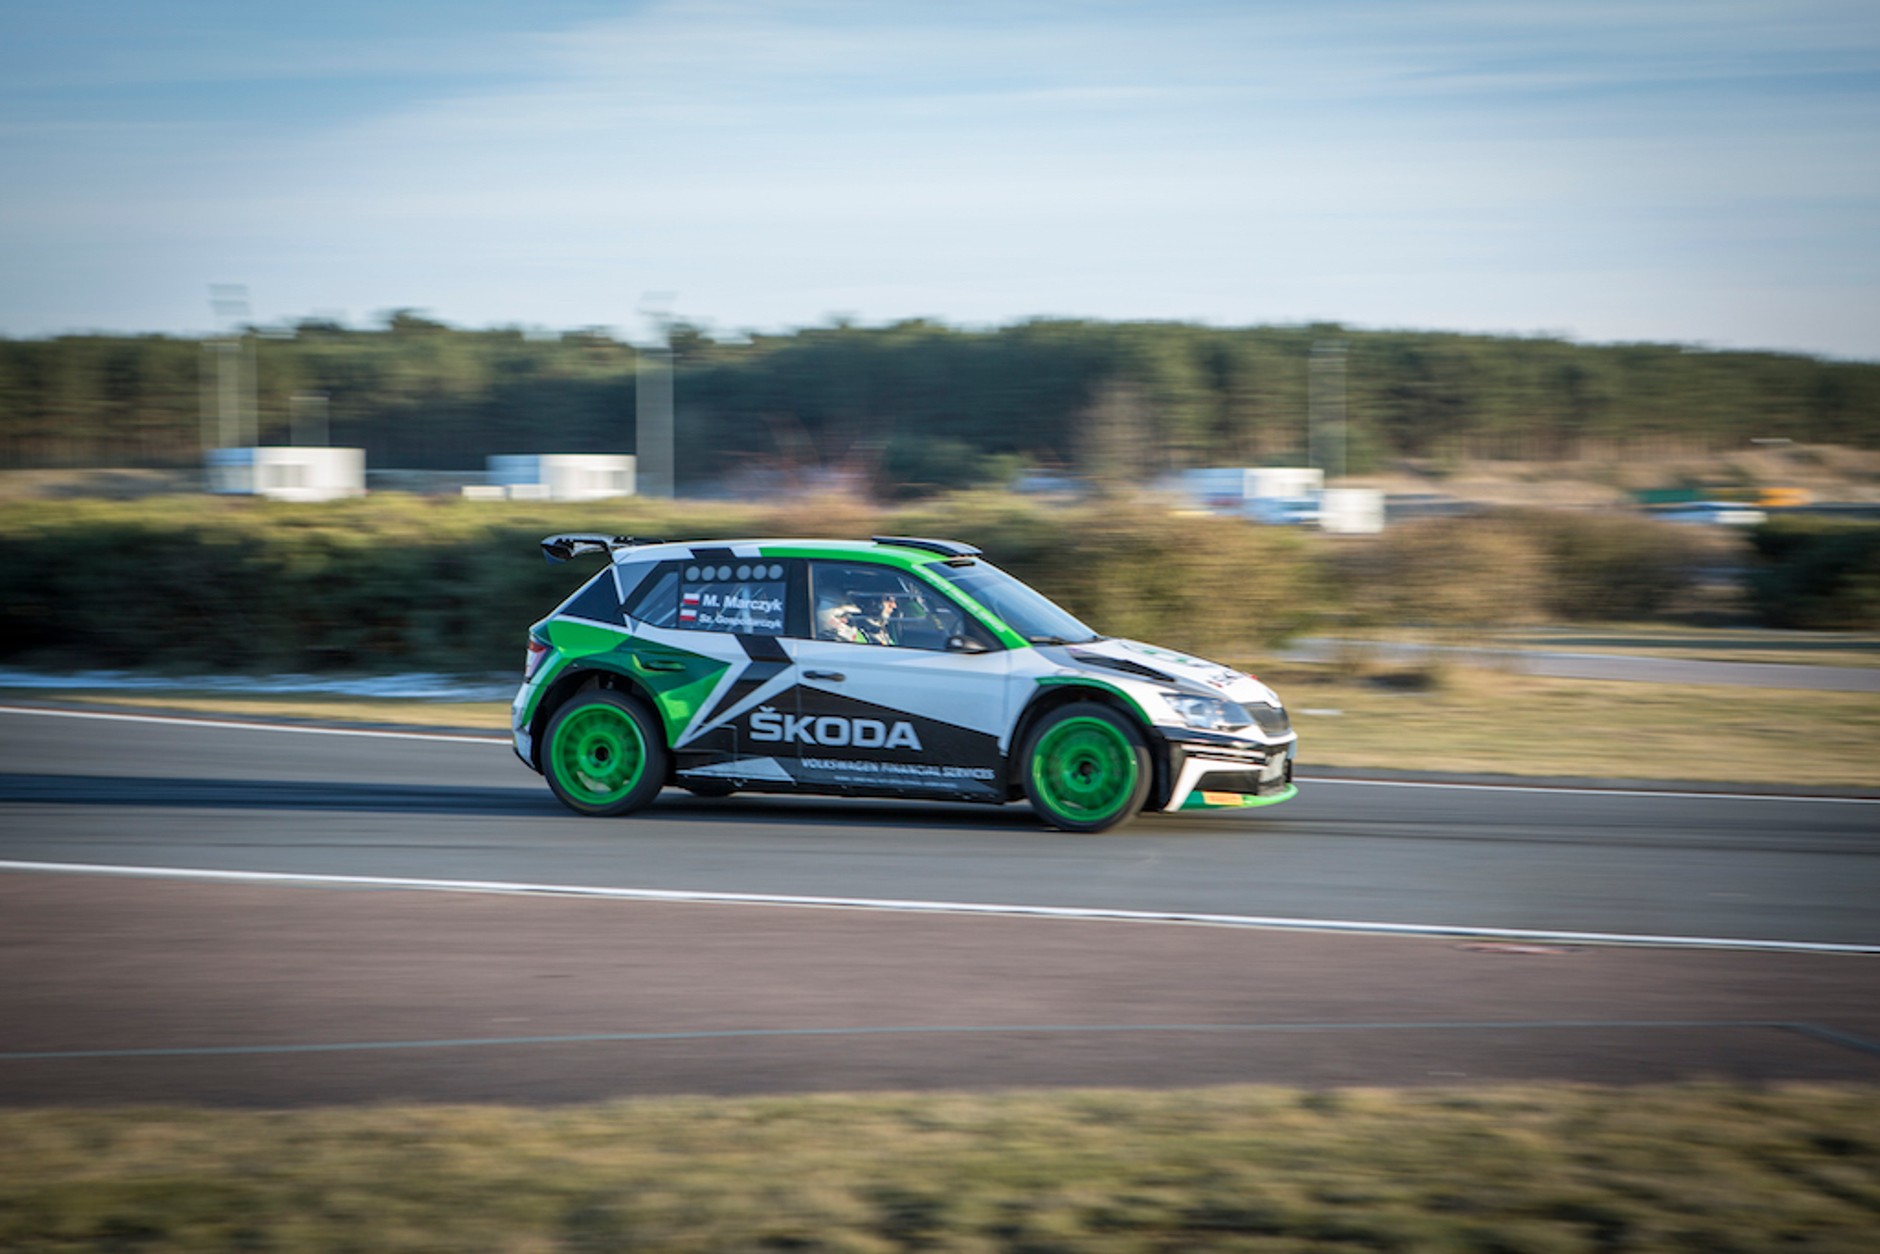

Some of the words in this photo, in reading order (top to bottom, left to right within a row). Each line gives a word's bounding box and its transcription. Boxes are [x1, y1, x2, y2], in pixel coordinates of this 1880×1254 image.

[703, 594, 720, 607] M.
[723, 595, 782, 613] Marczyk
[750, 705, 923, 750] ŠKODA
[801, 758, 879, 772] VOLKSWAGEN
